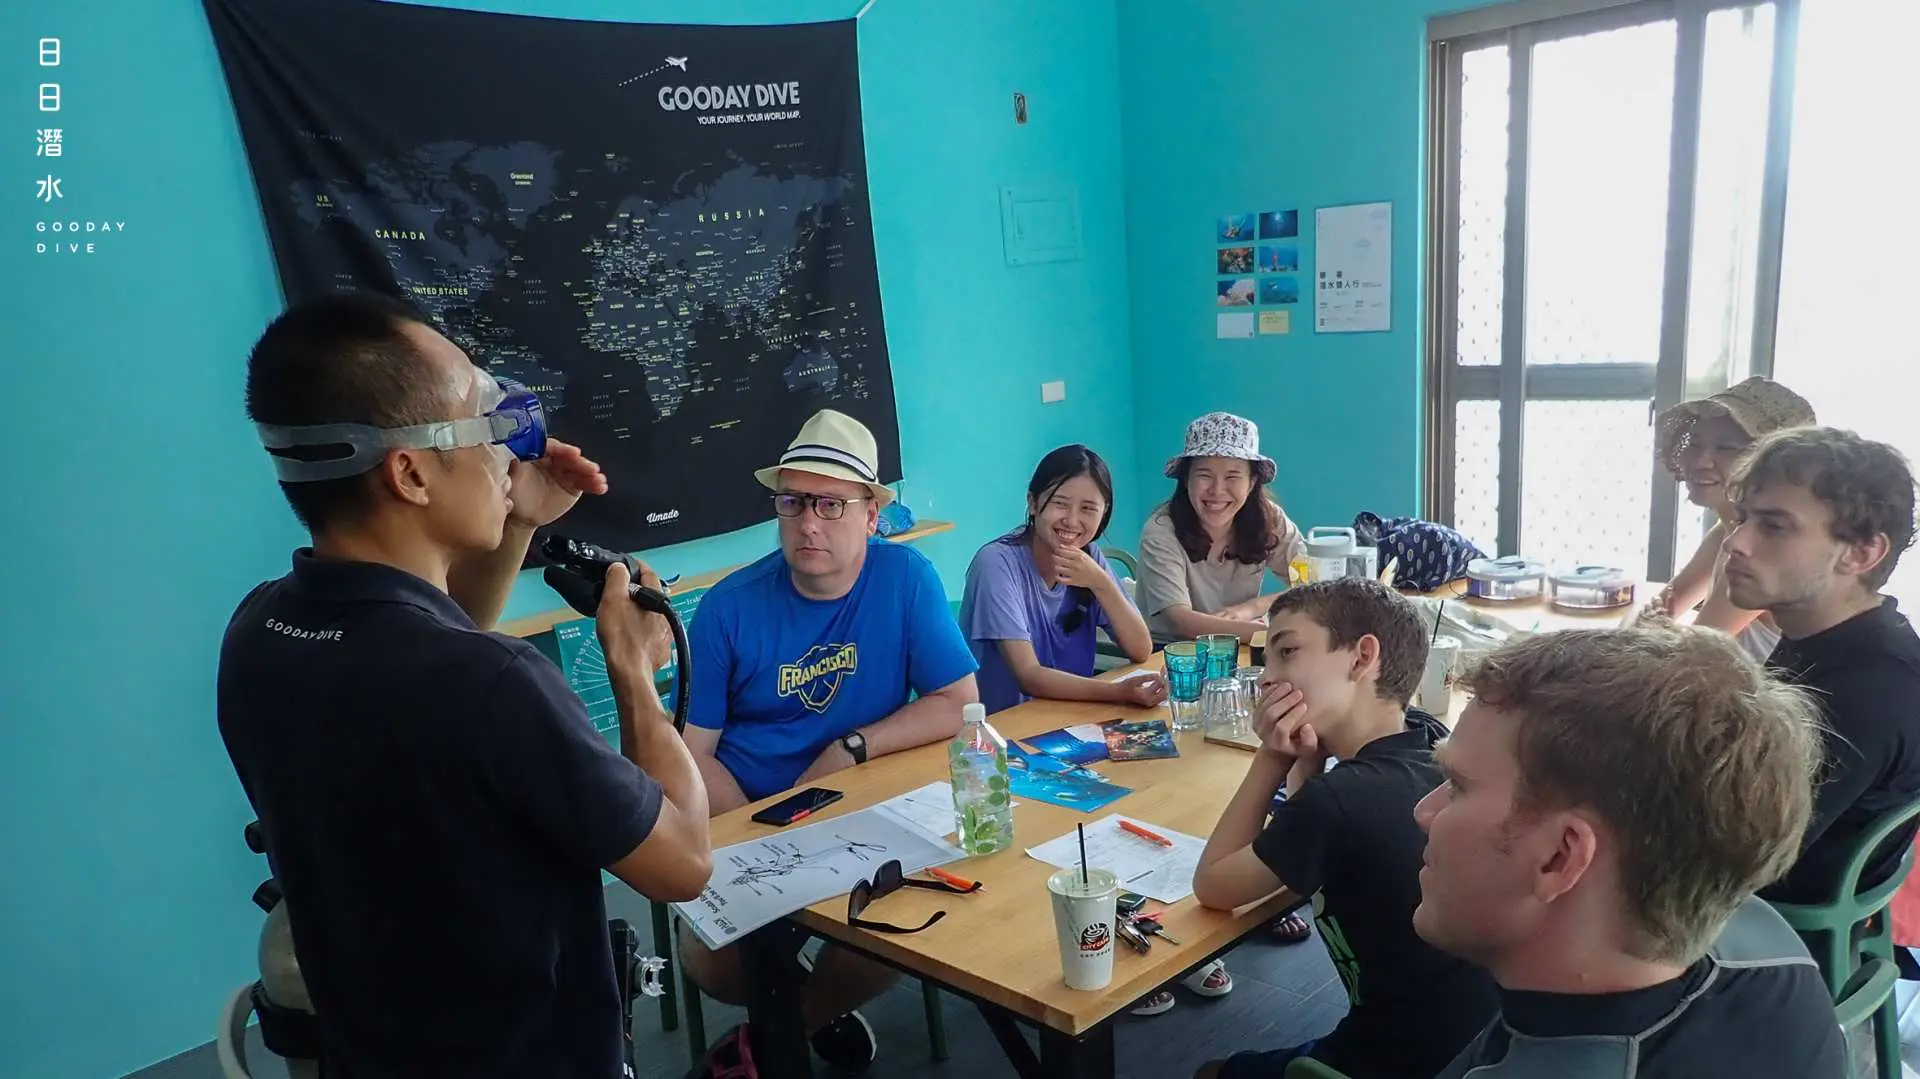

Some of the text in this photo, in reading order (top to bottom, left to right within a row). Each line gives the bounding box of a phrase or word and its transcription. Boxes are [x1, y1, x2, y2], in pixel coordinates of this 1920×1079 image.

[658, 81, 800, 111] GOODAY DIVE
[697, 115, 717, 125] YOUR
[746, 112, 764, 122] YOUR
[764, 111, 786, 121] WORLD
[698, 208, 765, 223] RUSSIA
[375, 229, 426, 241] CANADA
[411, 286, 469, 296] UNITED STATES
[781, 646, 855, 691] FRANCISCO
